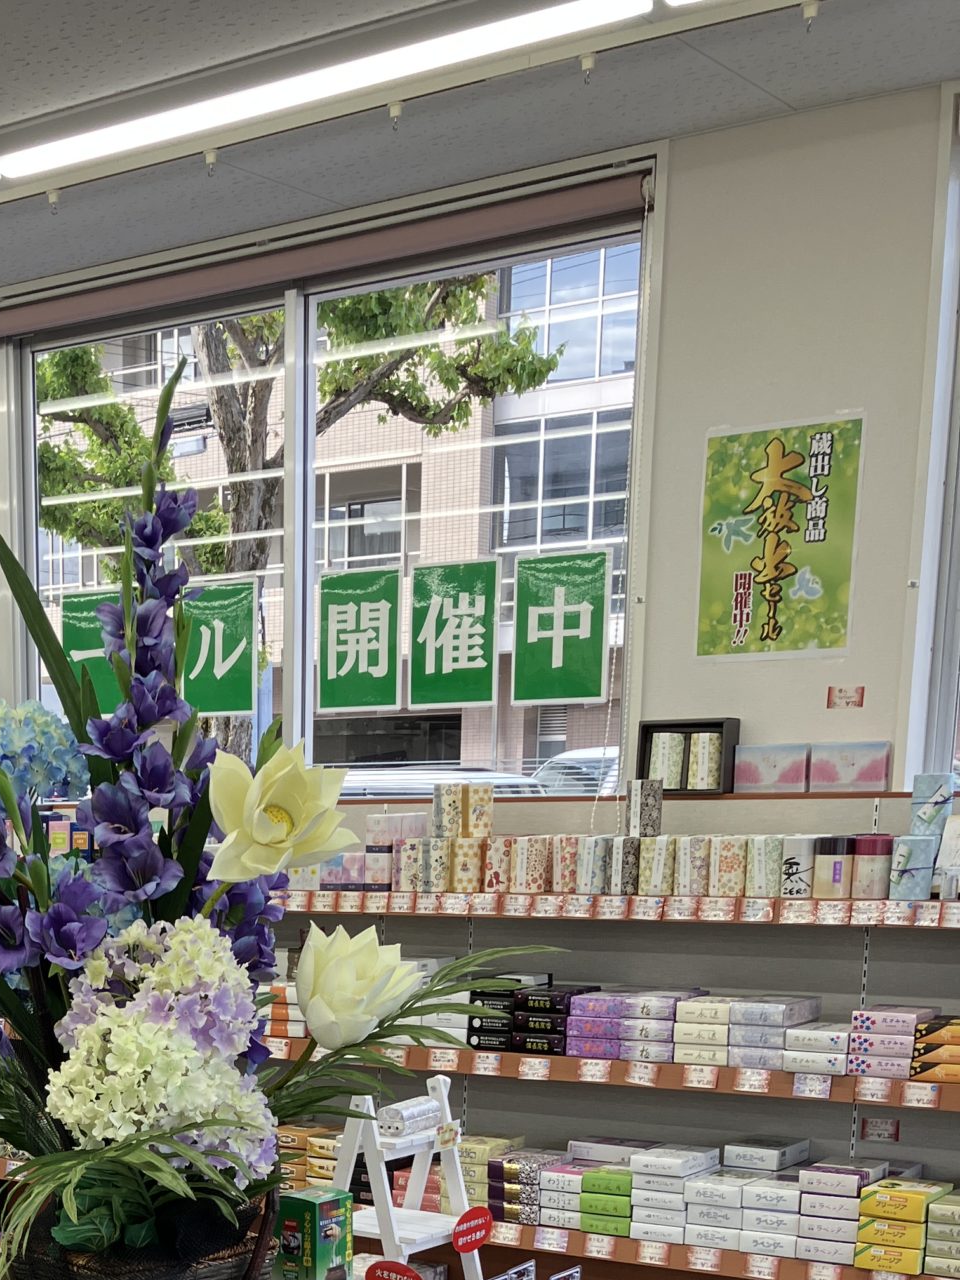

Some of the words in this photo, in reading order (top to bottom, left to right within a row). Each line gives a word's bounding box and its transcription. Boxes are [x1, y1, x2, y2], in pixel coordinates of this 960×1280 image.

[804, 431, 834, 543] 蔵出し商品
[188, 619, 248, 681] ル
[326, 598, 392, 681] 開
[417, 591, 489, 675] 催
[526, 586, 594, 669] 中
[735, 1153, 767, 1163] カモミール
[695, 1187, 727, 1200] カモミール
[755, 1192, 787, 1202] ラベンダー
[875, 1200, 908, 1211] フリージア
[698, 1209, 730, 1221] カモミール
[755, 1216, 788, 1227] ラベンダー
[696, 1231, 728, 1243] カモミール
[873, 1228, 906, 1239] フリージア
[752, 1238, 784, 1250] ラベンダー
[869, 1254, 902, 1265] フリージア
